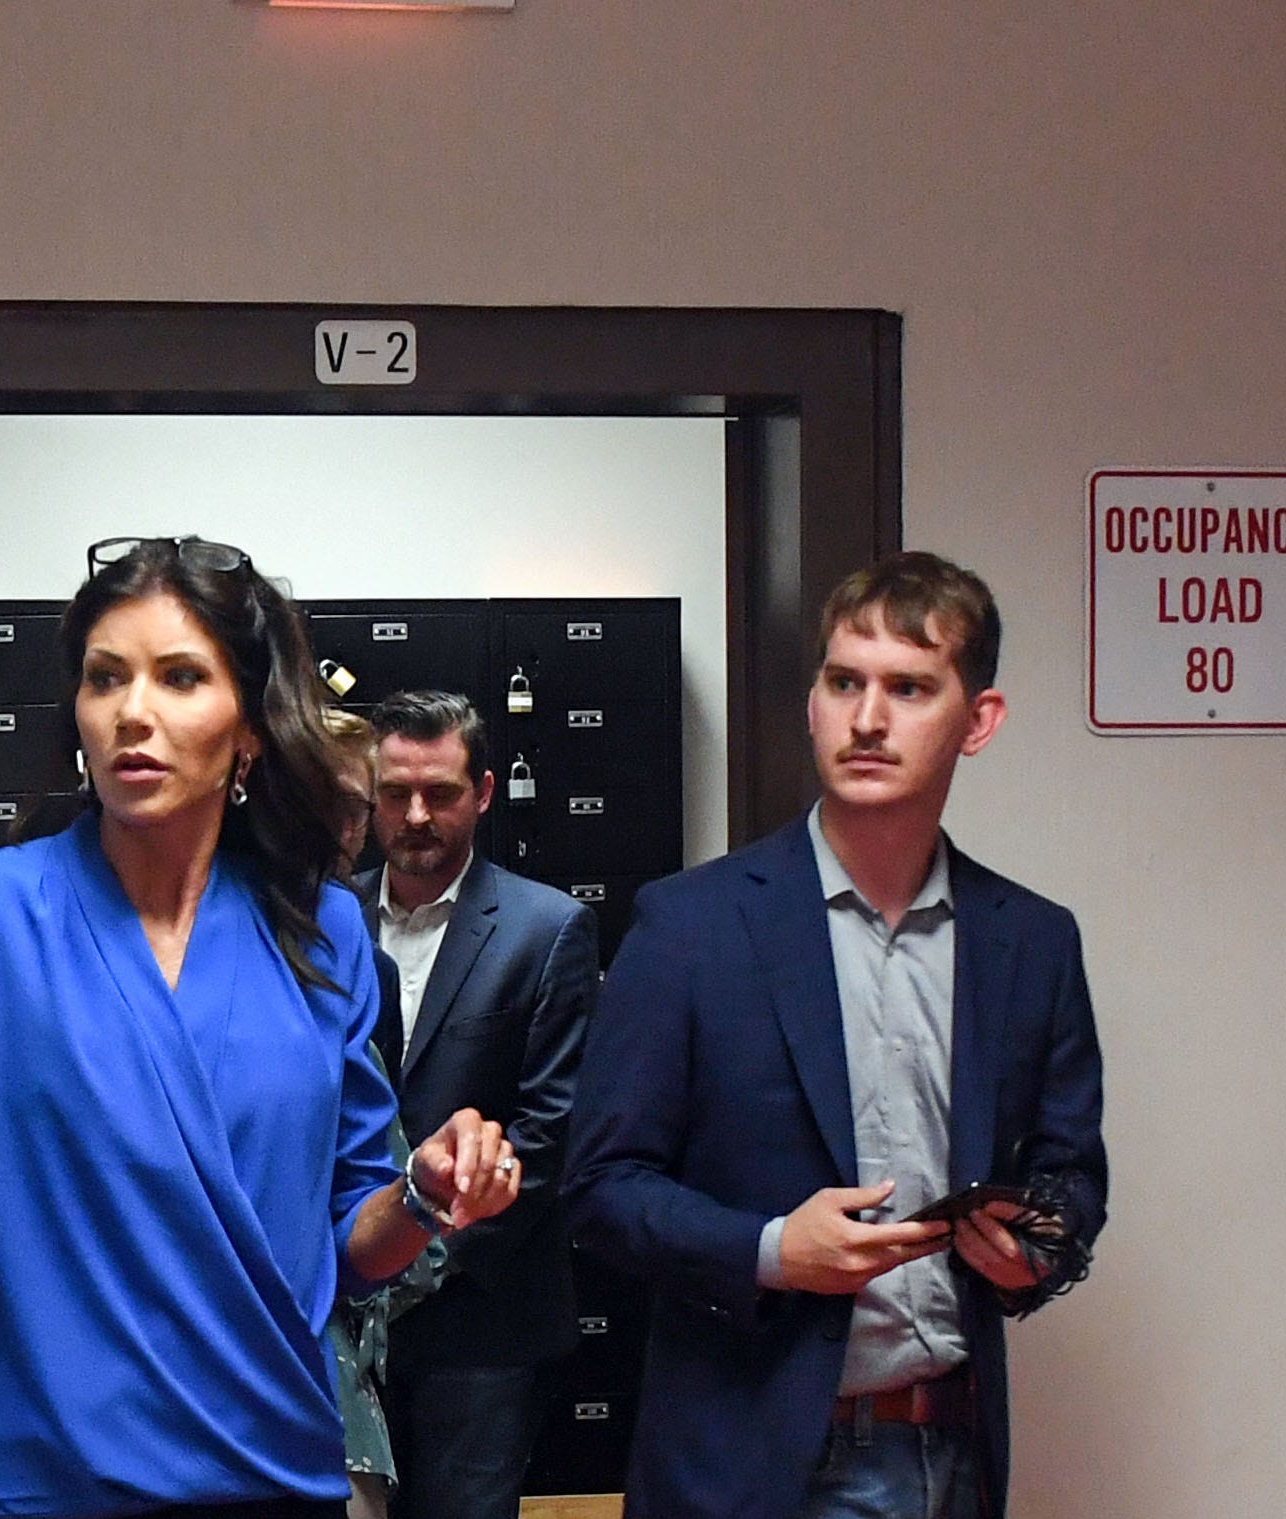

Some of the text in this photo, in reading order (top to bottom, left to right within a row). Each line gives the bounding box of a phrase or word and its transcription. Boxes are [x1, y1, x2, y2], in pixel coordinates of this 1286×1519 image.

[322, 331, 409, 373] V-2
[1158, 576, 1262, 623] LOAD
[1185, 646, 1233, 693] 80
